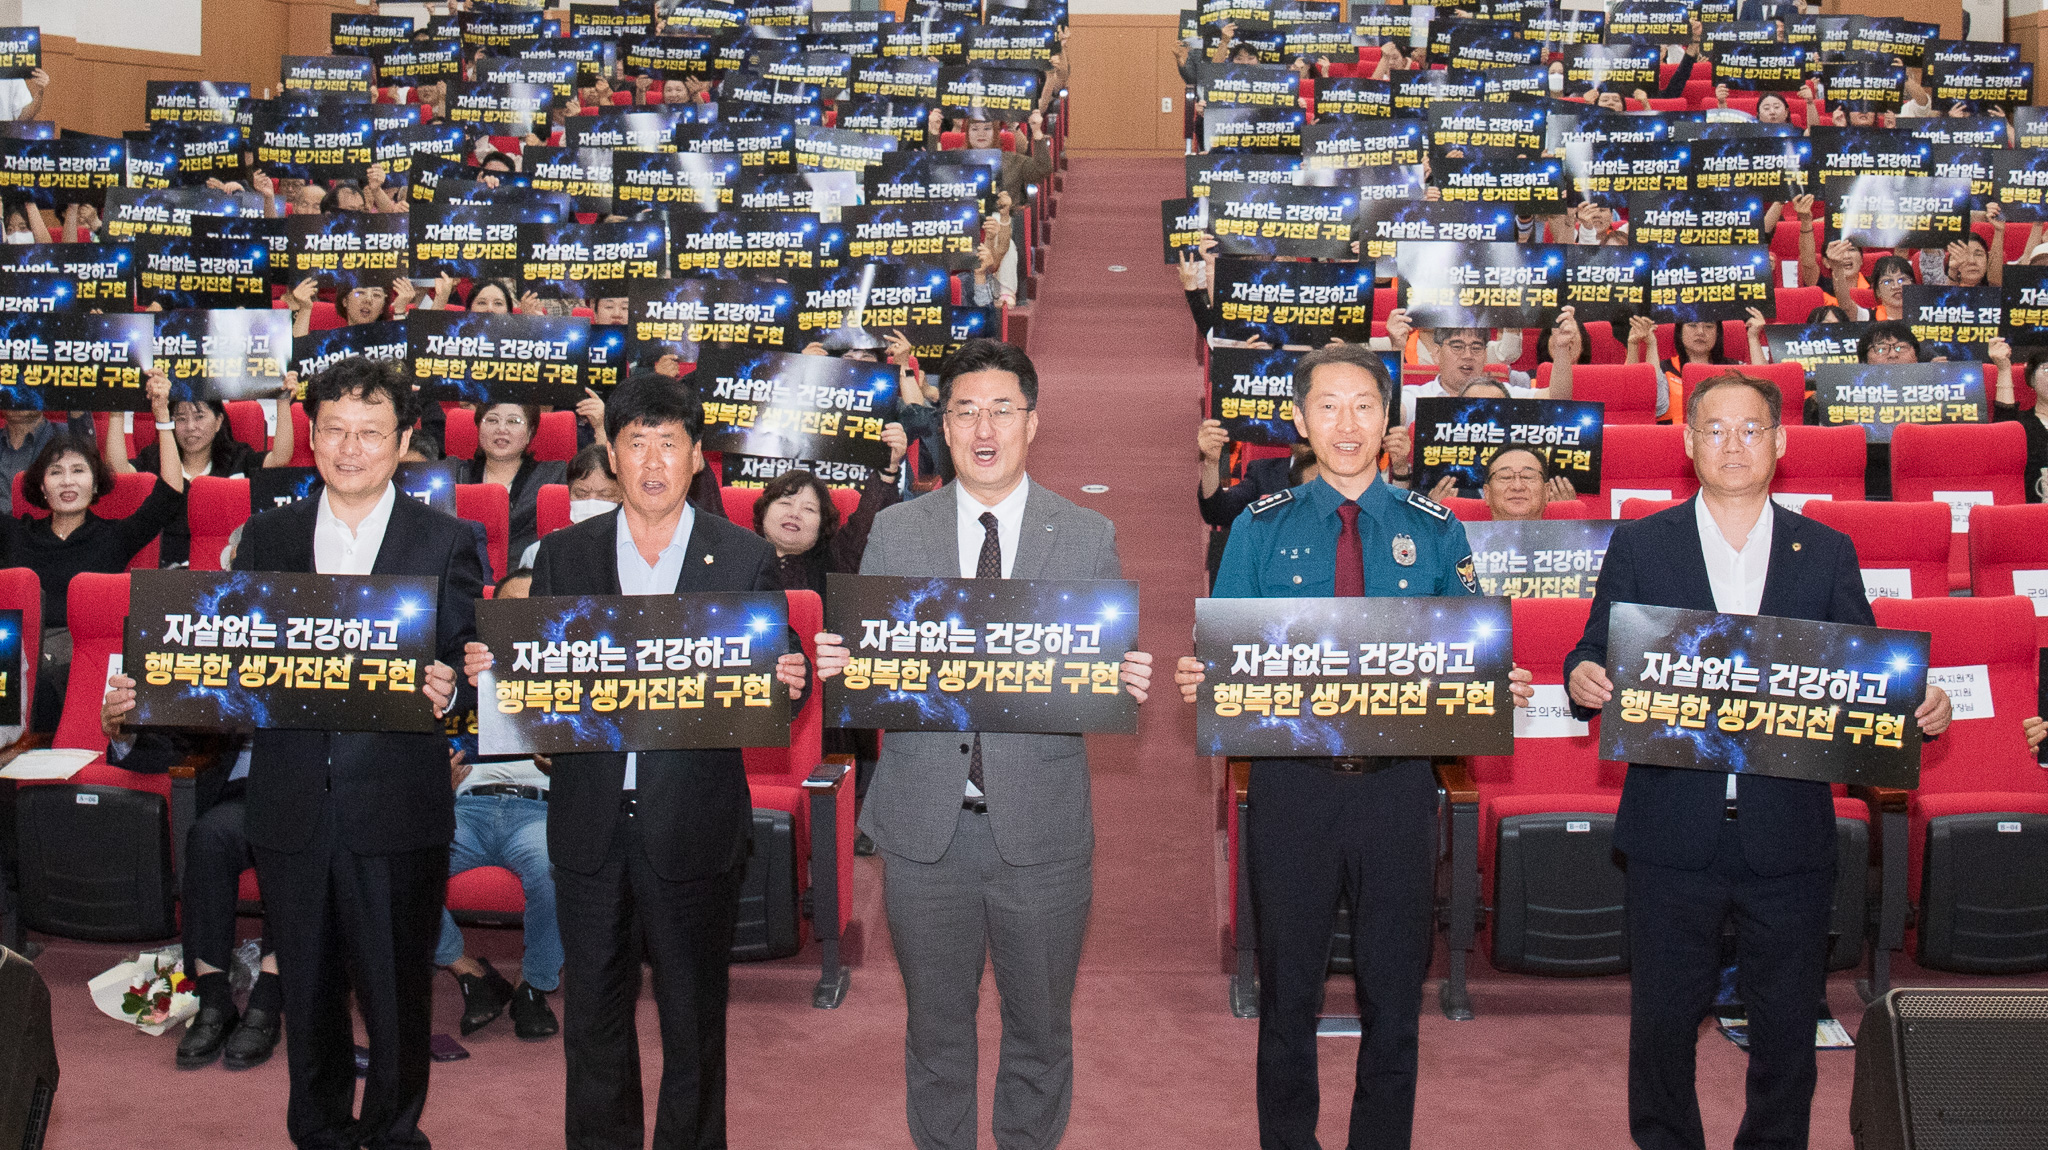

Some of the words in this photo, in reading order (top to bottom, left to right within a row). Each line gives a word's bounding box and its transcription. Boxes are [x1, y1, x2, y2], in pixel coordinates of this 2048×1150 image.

[1440, 116, 1486, 130] 자살없는
[1489, 118, 1533, 132] 건강하고
[263, 133, 310, 147] 자살없는
[314, 133, 363, 147] 건강하고
[1434, 131, 1468, 145] 행복한
[1471, 132, 1515, 147] 생거진천
[1518, 134, 1540, 148] 구현
[4, 156, 55, 171] 자살없는
[58, 157, 110, 172] 건강하고
[256, 149, 292, 162] 행복한
[295, 149, 343, 163] 생거진천
[346, 149, 372, 164] 구현
[1702, 156, 1749, 171] 자살없는
[1752, 153, 1799, 169] 건강하고
[1631, 160, 1680, 174] 건강하고
[0, 173, 36, 186] 행복한
[38, 173, 90, 188] 생거진천
[93, 174, 119, 189] 구현
[1448, 173, 1497, 186] 자살없는
[1500, 173, 1549, 186] 건강하고
[1611, 176, 1660, 191] 생거진천
[1662, 176, 1688, 191] 구현
[1696, 173, 1731, 188] 행복한
[1733, 171, 1781, 187] 생거진천
[1441, 188, 1479, 201] 행복한
[1482, 188, 1530, 201] 생거진천
[1533, 187, 1558, 200] 구현
[1224, 201, 1282, 219] 자살없는
[1286, 205, 1342, 221] 건강하고
[1644, 210, 1697, 226] 자살없는
[1701, 211, 1751, 226] 건강하고
[856, 222, 908, 238] 자살없는
[912, 219, 963, 236] 건강하고
[1215, 219, 1258, 236] 행복한
[1261, 221, 1319, 239] 생거진천
[1322, 224, 1350, 241] 구현
[1635, 228, 1677, 244] 행복한
[1680, 228, 1731, 244] 생거진천
[1734, 228, 1759, 244] 구현
[685, 232, 742, 249] 자살없는
[747, 231, 803, 248] 건강하고
[849, 240, 888, 257] 행복한
[891, 238, 943, 255] 생거진천
[946, 236, 972, 252] 구현
[531, 243, 588, 260] 자살없는
[592, 243, 647, 260] 건강하고
[677, 252, 720, 269] 행복한
[724, 251, 781, 268] 생거진천
[784, 250, 812, 267] 구현
[146, 255, 196, 272] 자살없는
[200, 257, 253, 274] 건강하고
[522, 263, 566, 280] 행복한
[569, 262, 625, 279] 생거진천
[629, 261, 656, 278] 구현
[139, 273, 177, 289] 행복한
[180, 274, 232, 293] 생거진천
[235, 277, 263, 295] 구현
[1230, 282, 1295, 302] 자살없는
[1299, 286, 1359, 304] 건강하고
[871, 285, 931, 305] 건강하고
[646, 301, 709, 320] 자살없는
[714, 303, 775, 322] 건강하고
[796, 311, 843, 330] 행복한
[911, 305, 942, 325] 구현
[1220, 304, 1270, 322] 행복한
[1273, 305, 1334, 324] 생거진천
[1337, 307, 1366, 325] 구현
[636, 322, 684, 340] 행복한
[687, 323, 750, 343] 생거진천
[753, 325, 784, 344] 구현
[425, 335, 495, 357] 자살없는
[500, 339, 568, 360] 건강하고
[414, 358, 467, 379] 행복한
[471, 360, 540, 382] 생거진천
[543, 363, 577, 384] 구현
[1836, 385, 1898, 402] 자살없는
[1902, 384, 1965, 402] 건강하고
[1221, 397, 1275, 420] 행복한
[1827, 405, 1875, 423] 행복한
[1879, 405, 1941, 422] 생거진천
[1946, 403, 1978, 421] 구현
[702, 402, 757, 427] 행복한
[844, 416, 883, 441] 구현
[1434, 422, 1504, 443] 자살없는
[1510, 425, 1581, 445] 건강하고
[1423, 446, 1476, 466] 행복한
[1555, 449, 1591, 470] 구현
[163, 614, 277, 649] 자살없는
[286, 618, 399, 651] 건강하고
[860, 620, 976, 653] 자살없는
[986, 623, 1101, 655] 건강하고
[512, 639, 627, 674] 자살없는
[636, 635, 751, 671] 건강하고
[1231, 642, 1350, 676] 자살없는
[1359, 641, 1476, 676] 건강하고
[145, 653, 231, 686] 행복한
[238, 655, 353, 690] 생거진천
[360, 658, 416, 692] 구현
[843, 659, 930, 690] 행복한
[938, 660, 1054, 693] 생거진천
[1062, 662, 1119, 695] 구현
[1640, 651, 1760, 694] 자살없는
[1769, 664, 1890, 704] 건강하고
[495, 680, 583, 714] 행복한
[590, 676, 706, 712] 생거진천
[714, 673, 772, 708] 구현
[1213, 683, 1303, 717] 행복한
[1311, 682, 1429, 716] 생거진천
[1437, 680, 1495, 715] 구현
[1620, 689, 1710, 728] 행복한
[1717, 698, 1838, 741] 생거진천
[1844, 710, 1905, 749] 구현
